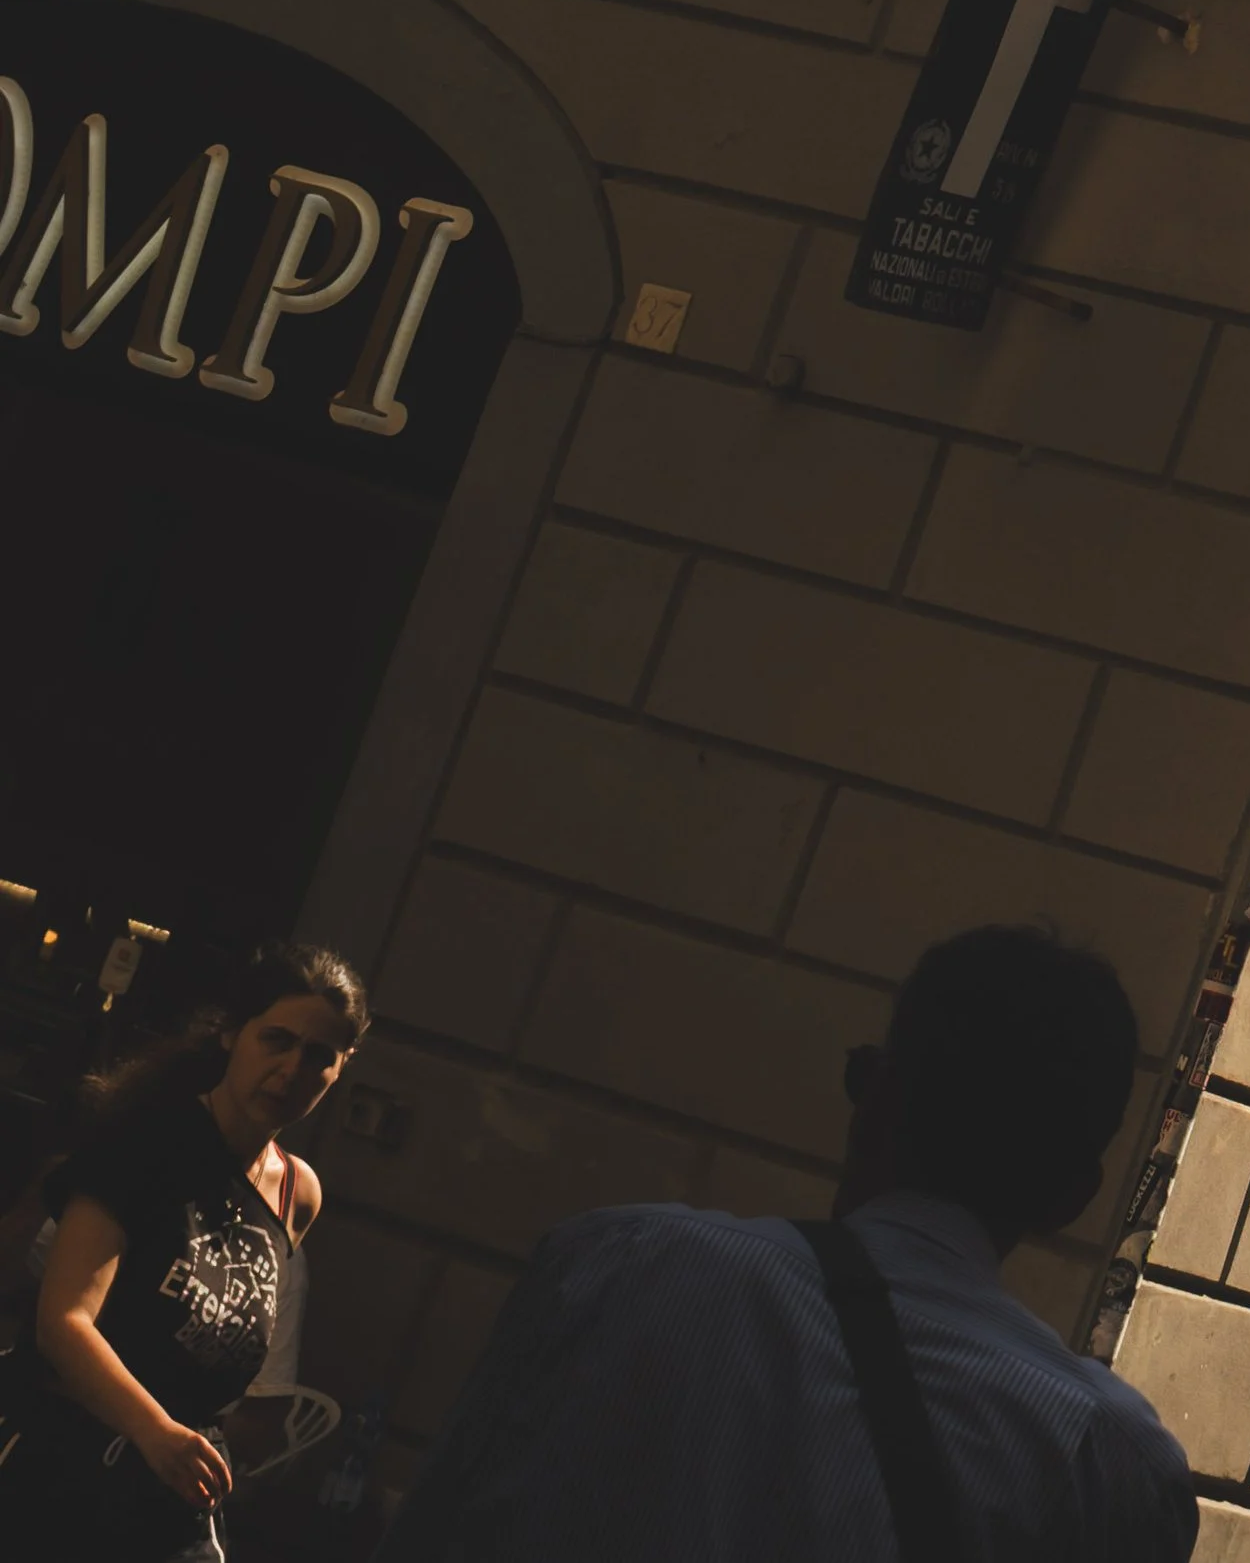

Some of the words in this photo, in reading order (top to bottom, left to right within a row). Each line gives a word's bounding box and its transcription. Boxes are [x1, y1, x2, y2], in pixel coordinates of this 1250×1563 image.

[919, 197, 962, 222] SALI
[965, 208, 981, 226] E
[891, 217, 994, 267] TABACCHI
[632, 293, 685, 340] 37
